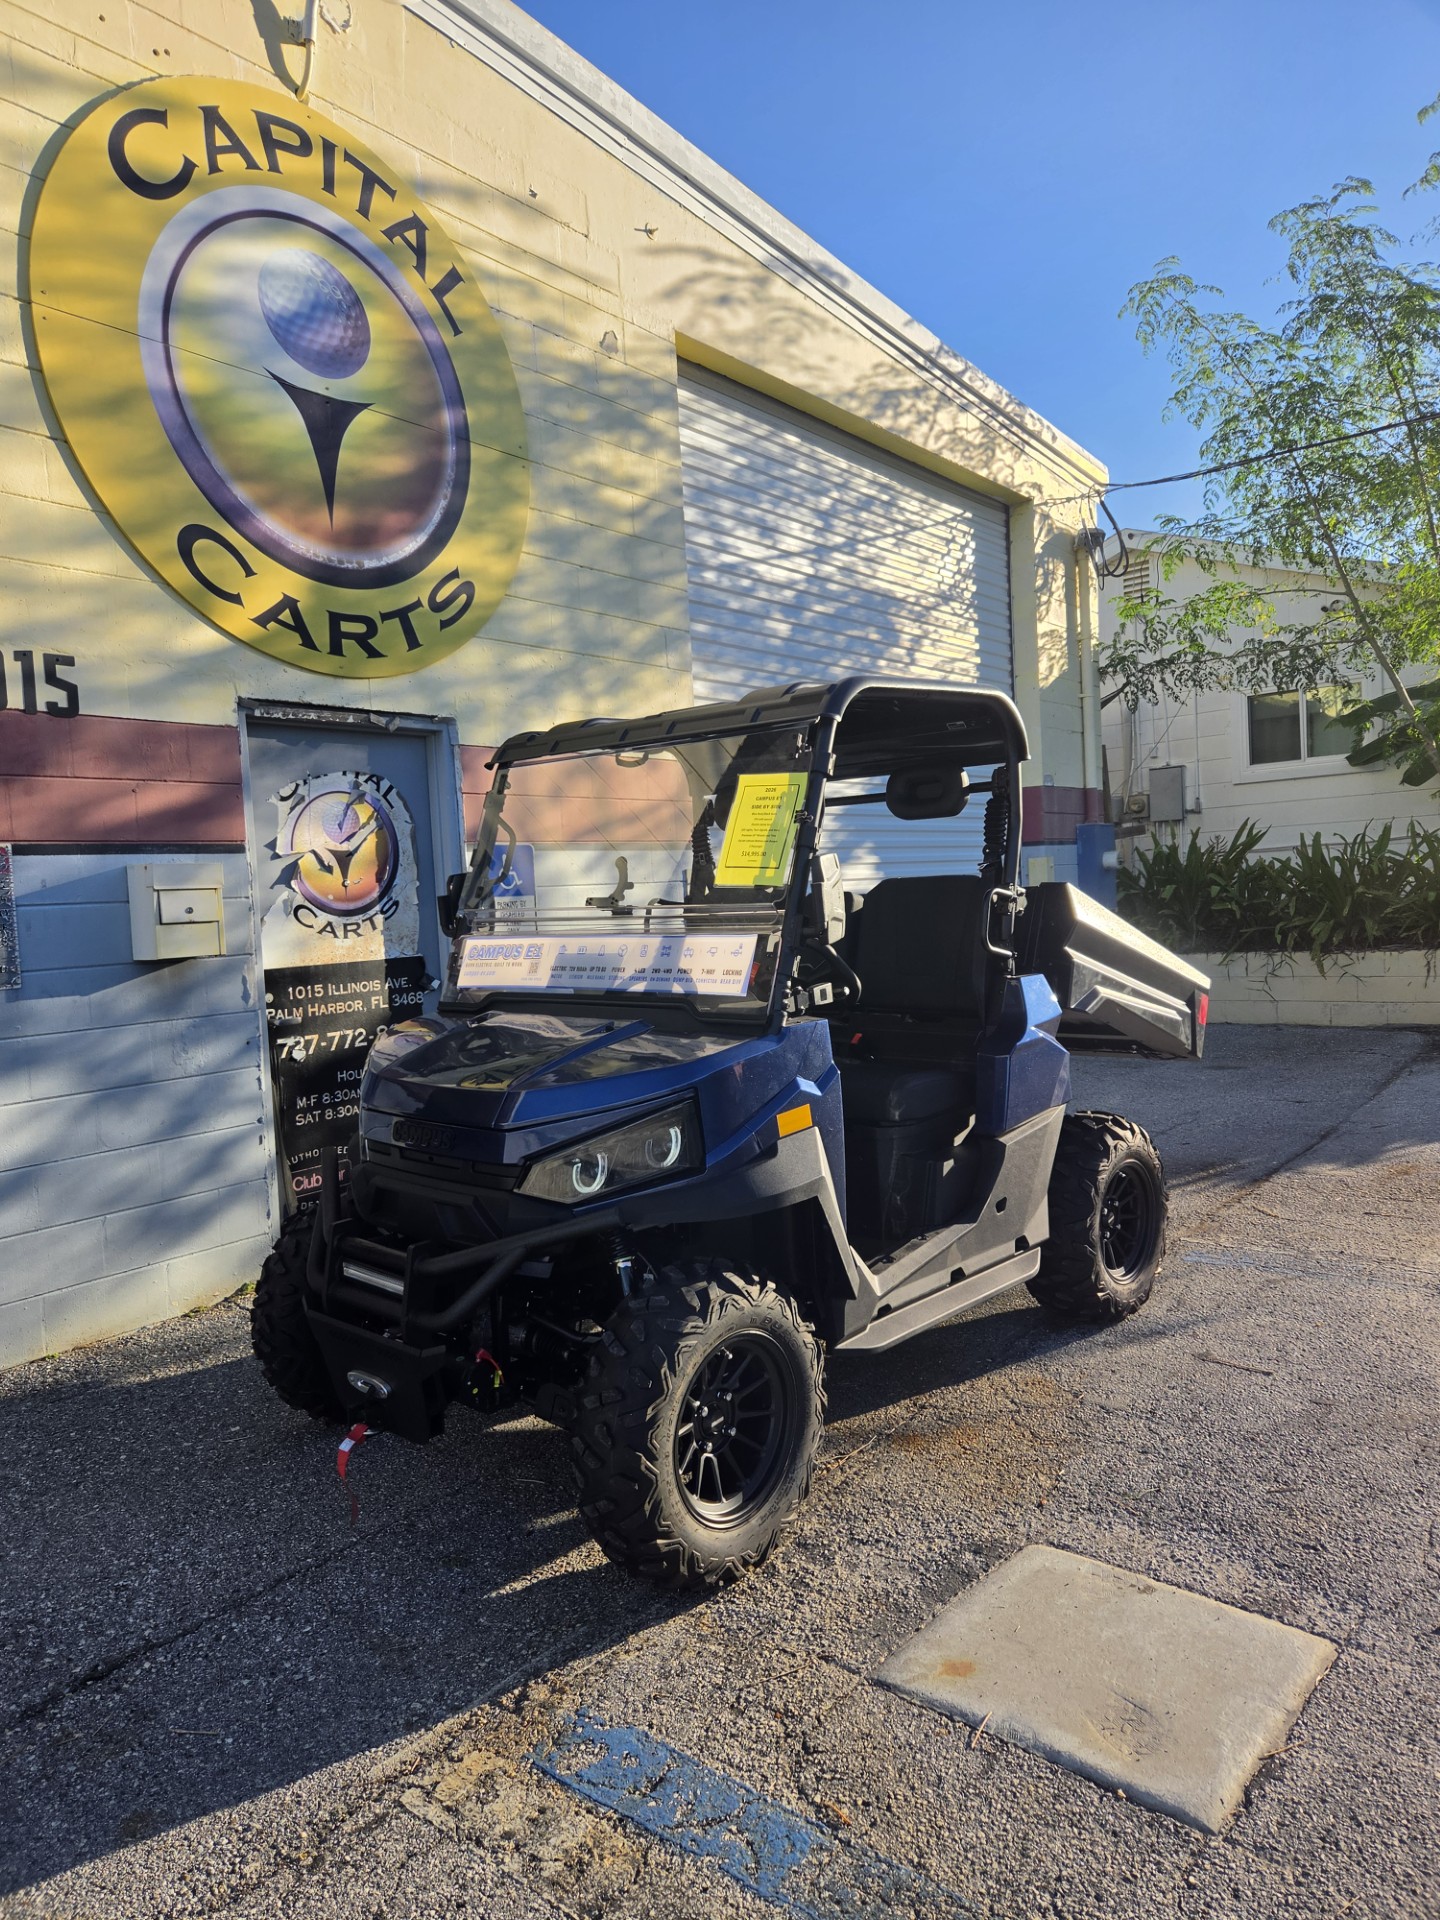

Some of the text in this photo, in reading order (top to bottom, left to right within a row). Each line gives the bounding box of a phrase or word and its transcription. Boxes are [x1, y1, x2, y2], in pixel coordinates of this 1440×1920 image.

[107, 104, 466, 337] CAPITAL
[176, 523, 477, 659] CARTS
[293, 896, 400, 940] CARTS
[467, 943, 524, 960] CAMPUS
[288, 977, 412, 1000] 1015 ILLINOIS AVE.
[267, 990, 429, 1021] PALM HARBOR, FL 3468
[297, 1094, 318, 1109] M-F
[295, 1110, 321, 1126] SAT
[292, 1173, 323, 1191] Club
